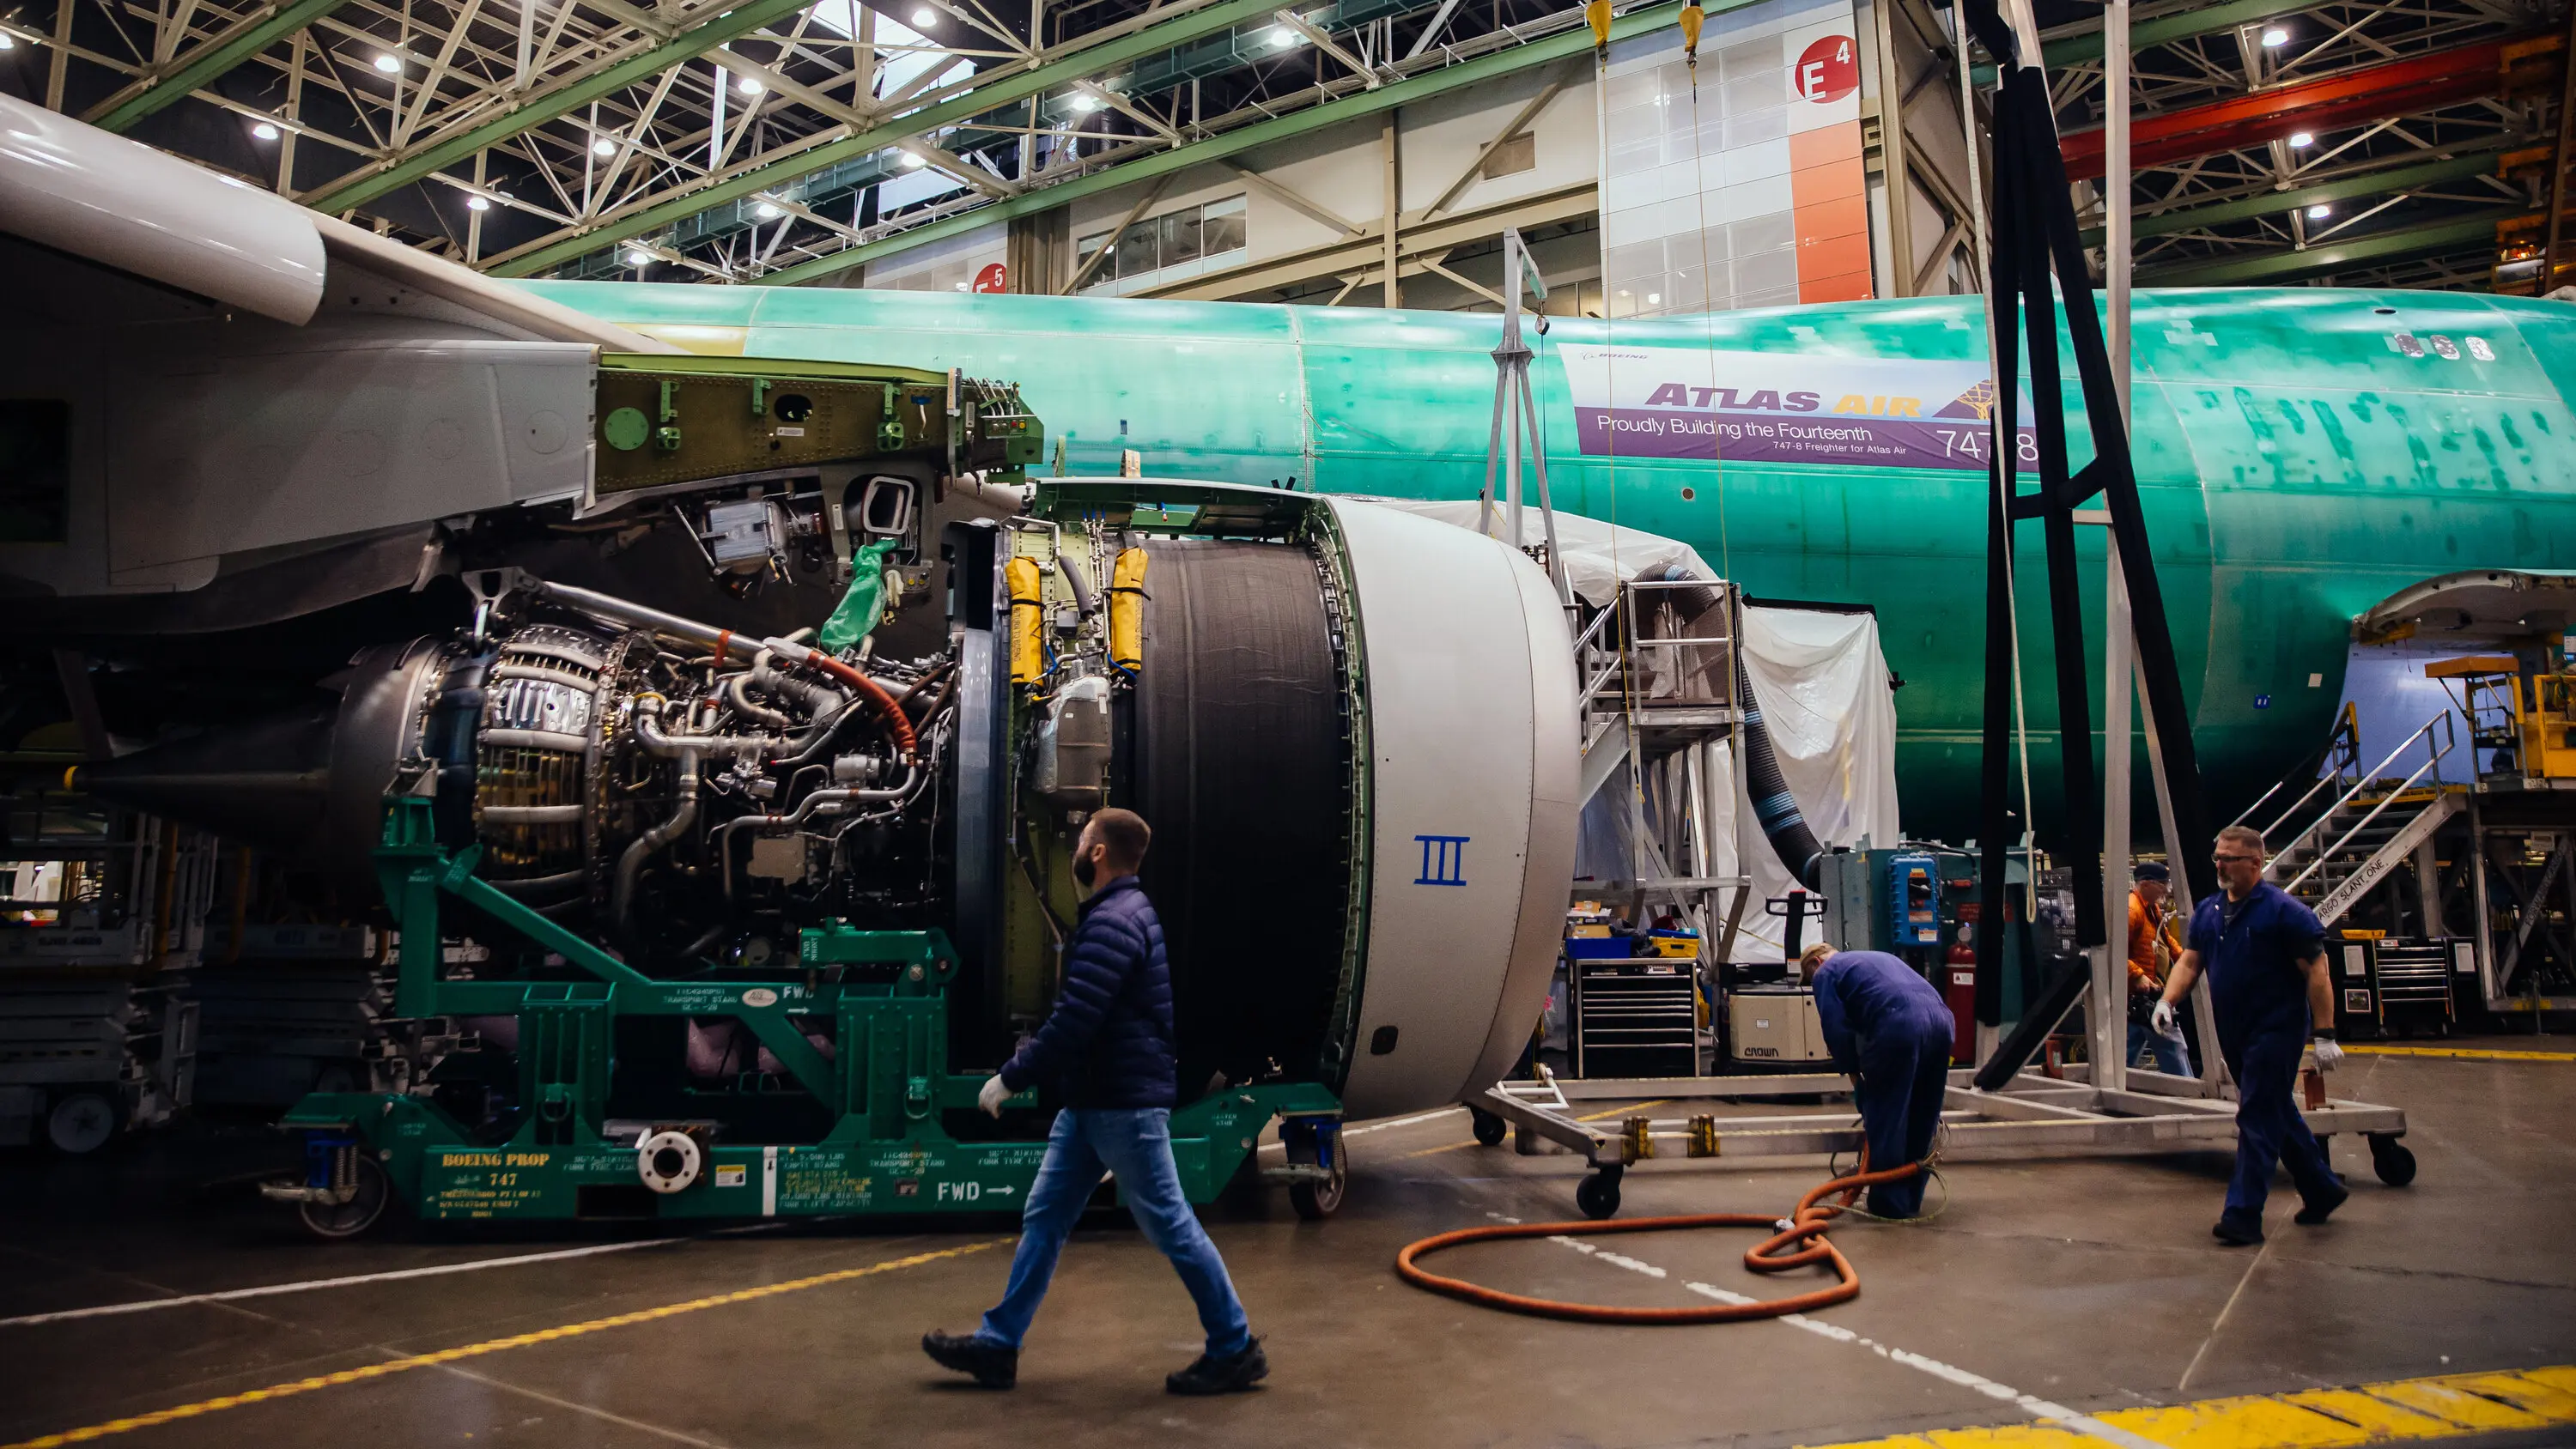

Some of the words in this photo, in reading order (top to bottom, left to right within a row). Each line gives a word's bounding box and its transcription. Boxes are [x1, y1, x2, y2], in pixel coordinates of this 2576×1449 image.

[1644, 383, 1820, 412] ATLAS
[1832, 395, 1922, 418] AIR
[1597, 415, 1665, 436] Proudly
[1670, 418, 1741, 440] Building
[1745, 421, 1774, 437] the
[1778, 423, 1873, 442] Fourteenth
[1773, 440, 1802, 452] 747-8
[1805, 442, 1848, 455] Freighter
[1850, 444, 1864, 453] for
[1866, 445, 1892, 455] Atlas
[1893, 446, 1907, 456] Air
[2318, 898, 2338, 921] ARGO
[2340, 876, 2366, 900] SLANT
[2366, 859, 2385, 877] ONE
[1744, 1046, 1779, 1058] CROWN
[442, 1153, 501, 1167] BOEING
[506, 1153, 550, 1167] PROP
[489, 1173, 519, 1186] 747
[937, 1181, 981, 1202] FWD
